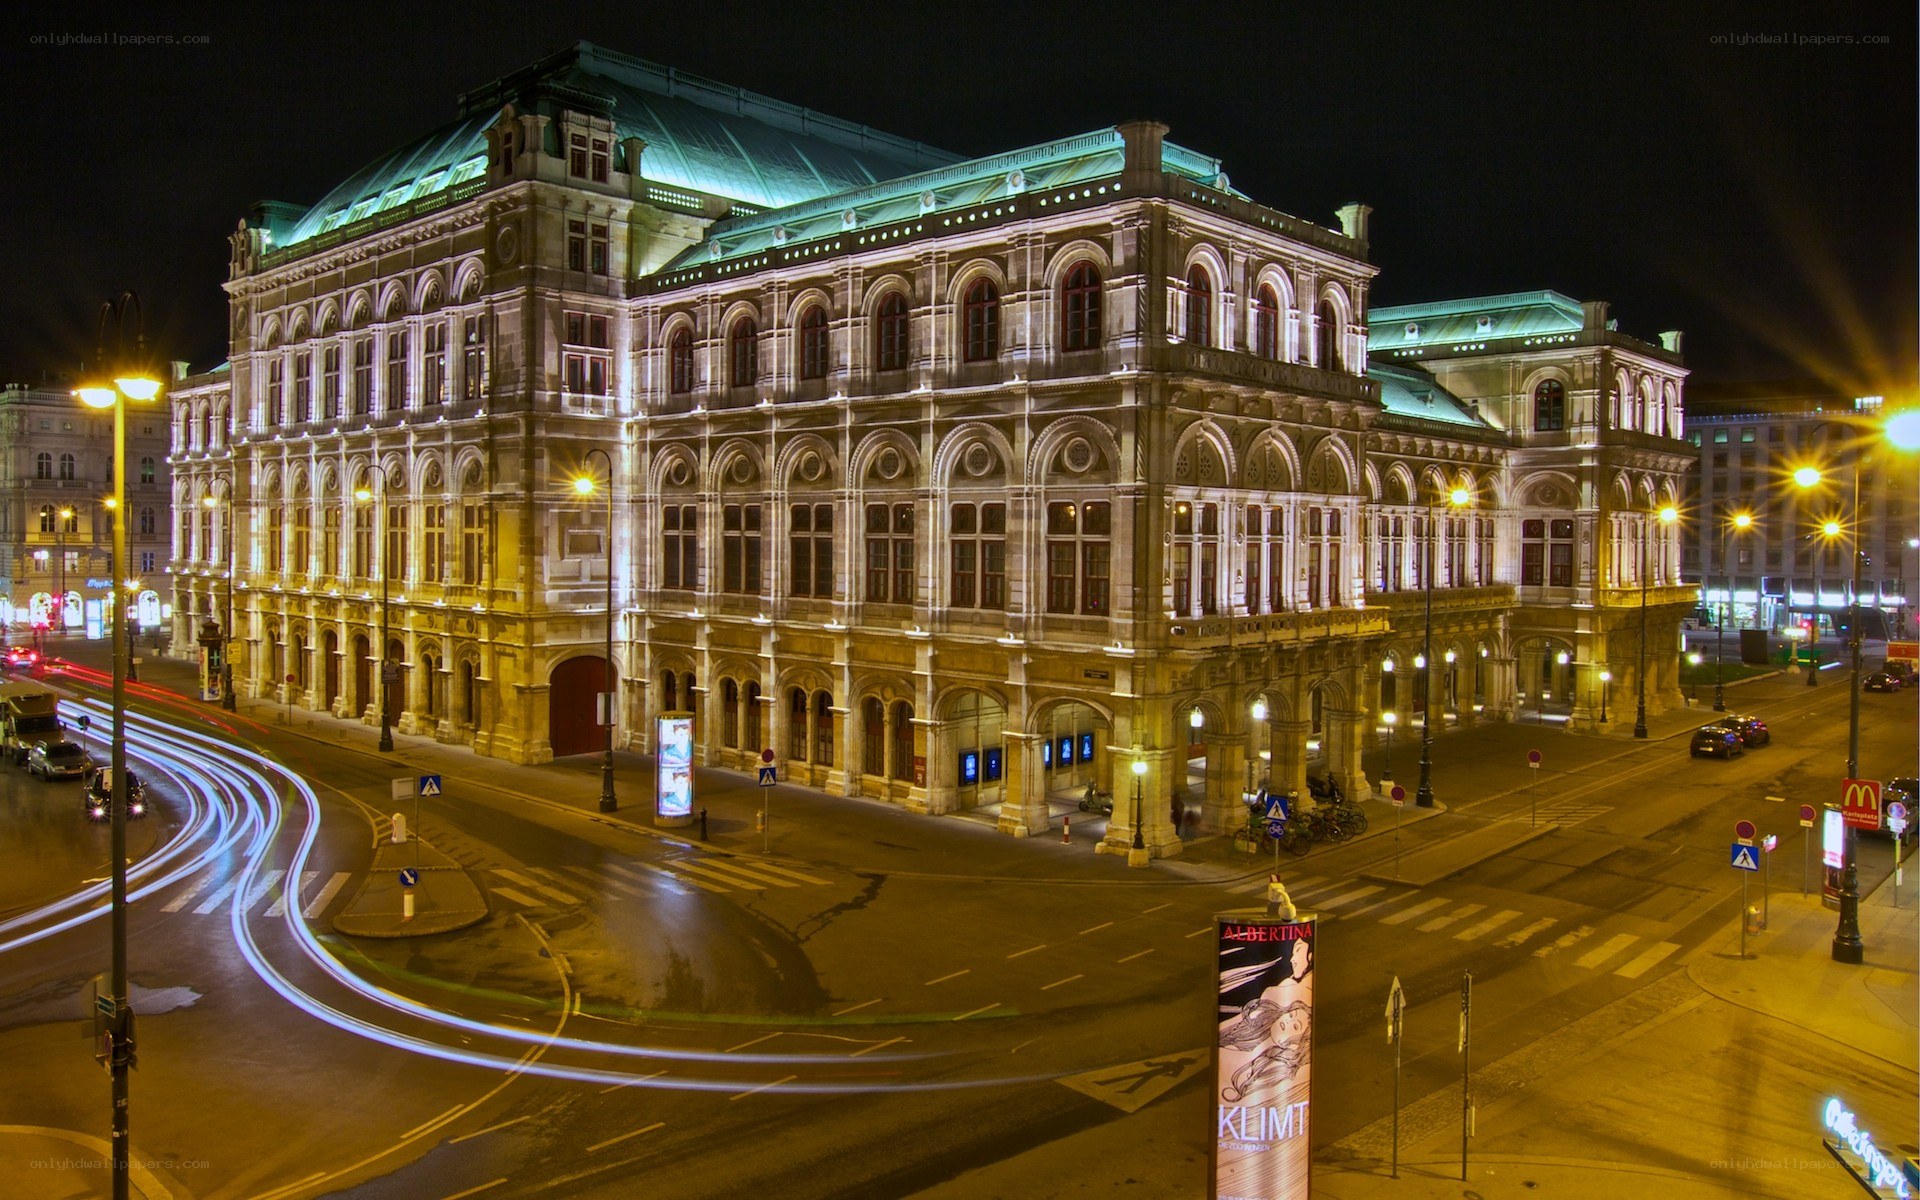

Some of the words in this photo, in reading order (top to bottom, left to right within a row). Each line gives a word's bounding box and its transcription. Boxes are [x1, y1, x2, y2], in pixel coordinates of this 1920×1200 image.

[1843, 810, 1878, 820] Karlsplatz
[1223, 924, 1312, 941] ALBERTINA
[1218, 1101, 1310, 1141] KLIMT
